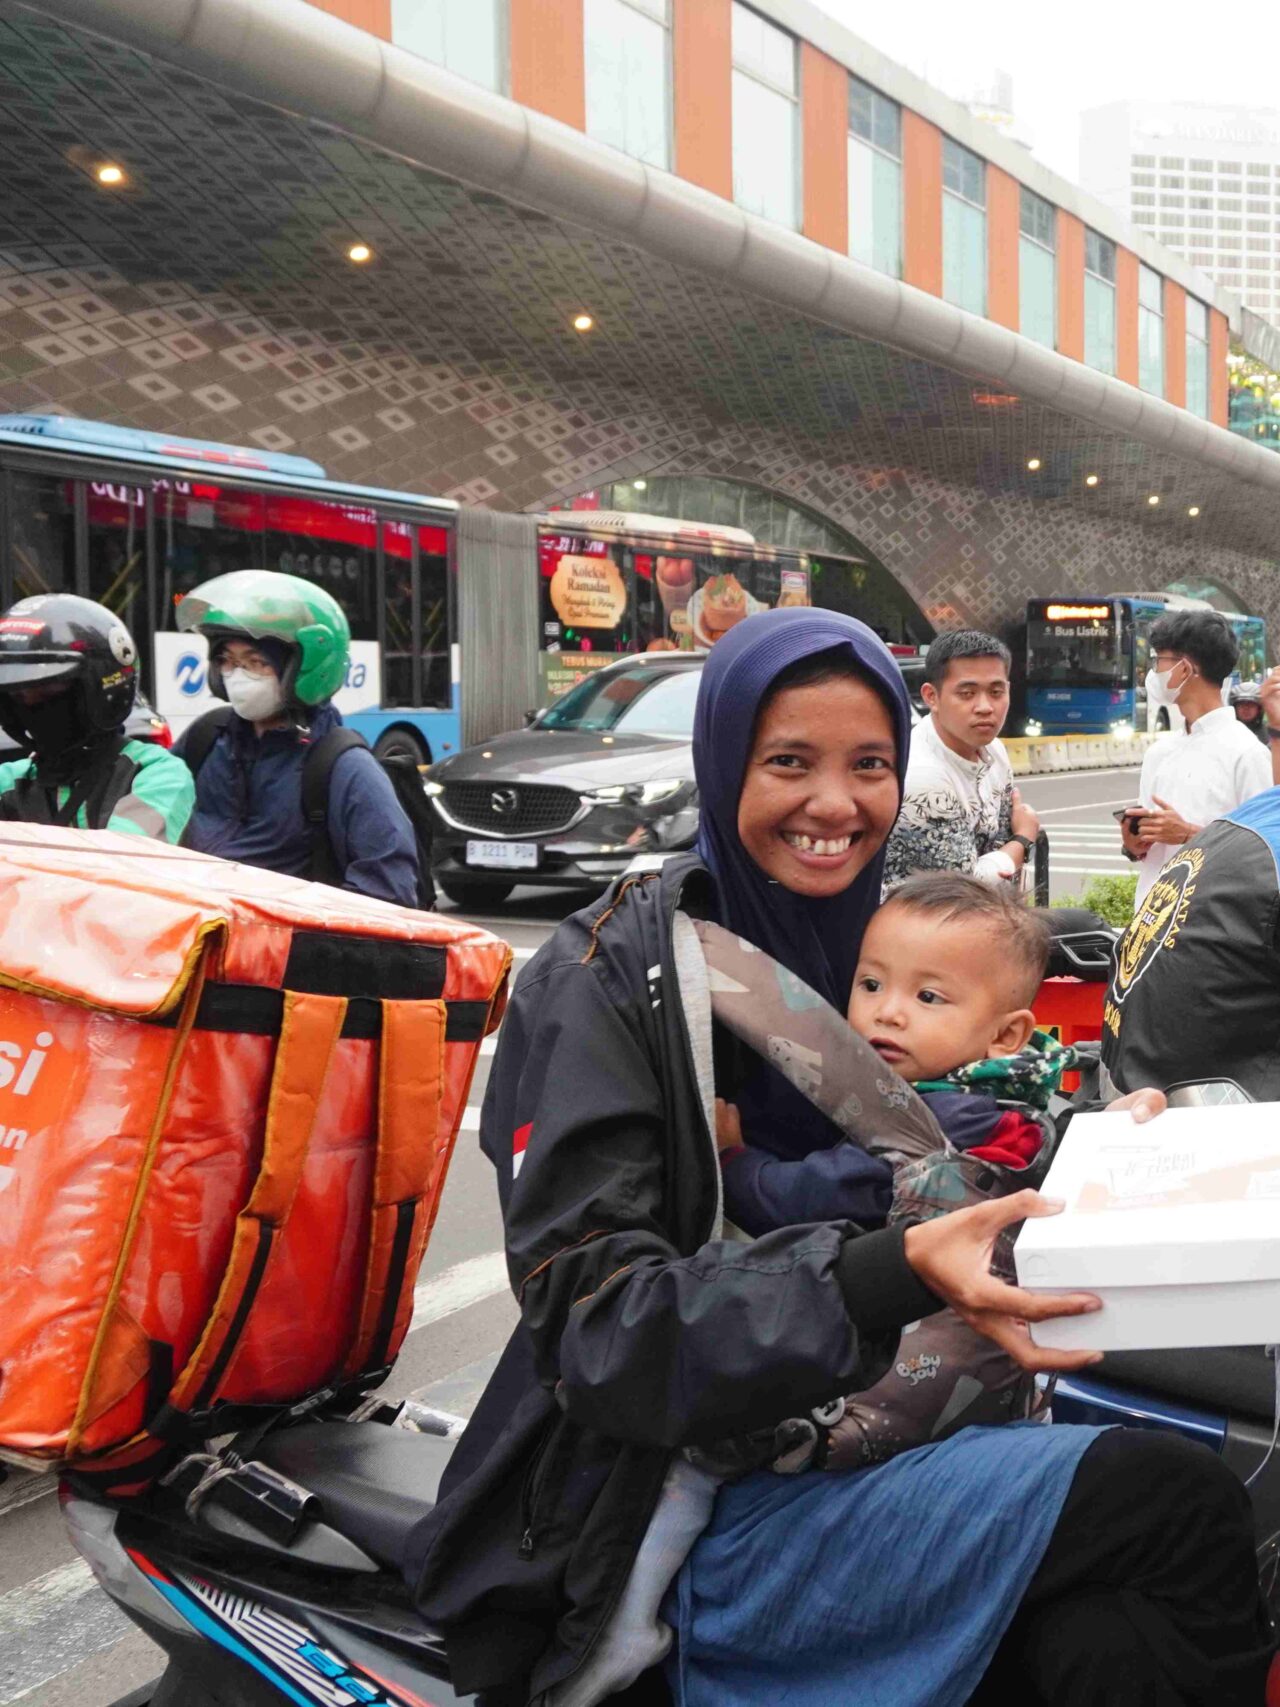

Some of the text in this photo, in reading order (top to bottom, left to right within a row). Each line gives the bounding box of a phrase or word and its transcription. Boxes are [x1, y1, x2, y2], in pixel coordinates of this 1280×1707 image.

[567, 577, 610, 593] Ramadan
[1054, 626, 1109, 637] Bus Listrik
[1164, 884, 1196, 950] BATAS
